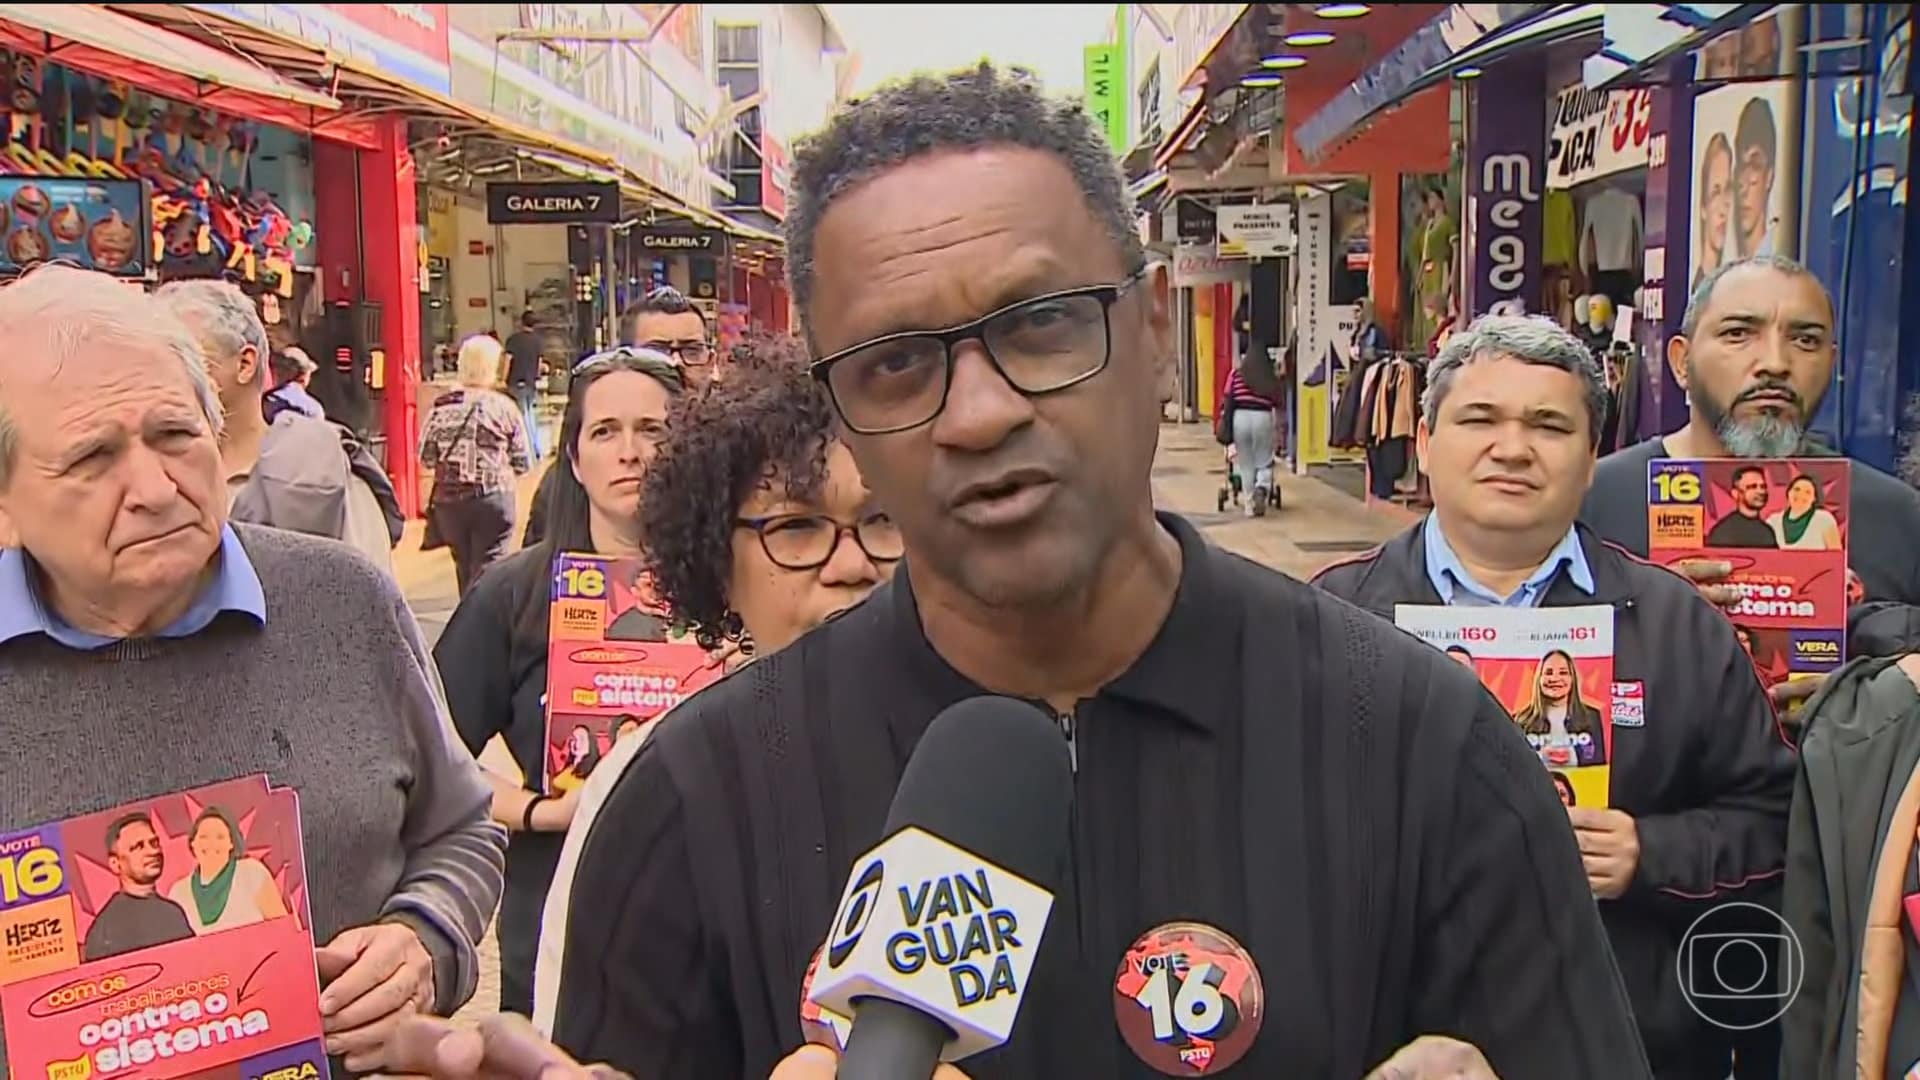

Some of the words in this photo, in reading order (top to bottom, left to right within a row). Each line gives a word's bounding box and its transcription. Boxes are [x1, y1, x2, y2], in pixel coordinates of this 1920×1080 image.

[1093, 53, 1109, 96] MIL
[506, 195, 585, 212] GALERIA
[587, 196, 600, 211] 7
[643, 234, 699, 248] GALERIA
[700, 236, 711, 247] 7
[1652, 472, 1701, 502] 16
[562, 568, 605, 598] 16
[1776, 585, 1792, 598] o
[1460, 627, 1498, 641] 160
[1569, 626, 1597, 641] 161
[1795, 641, 1839, 652] VERA
[663, 677, 677, 690] o
[0, 834, 41, 855] VOTE
[0, 847, 63, 904] 16
[898, 868, 994, 927] VAN
[6, 917, 63, 947] HERTZ
[886, 909, 1023, 975] GUAR
[1132, 953, 1190, 974] VOTE
[48, 981, 97, 1008] com
[101, 975, 127, 995] os
[100, 974, 231, 1014] trabalhadores
[949, 954, 1017, 1008] DA
[1136, 962, 1224, 1040] 16
[79, 996, 201, 1046] contra
[204, 993, 229, 1014] o
[94, 1008, 270, 1073] sistema
[1179, 1047, 1211, 1062] PSTU
